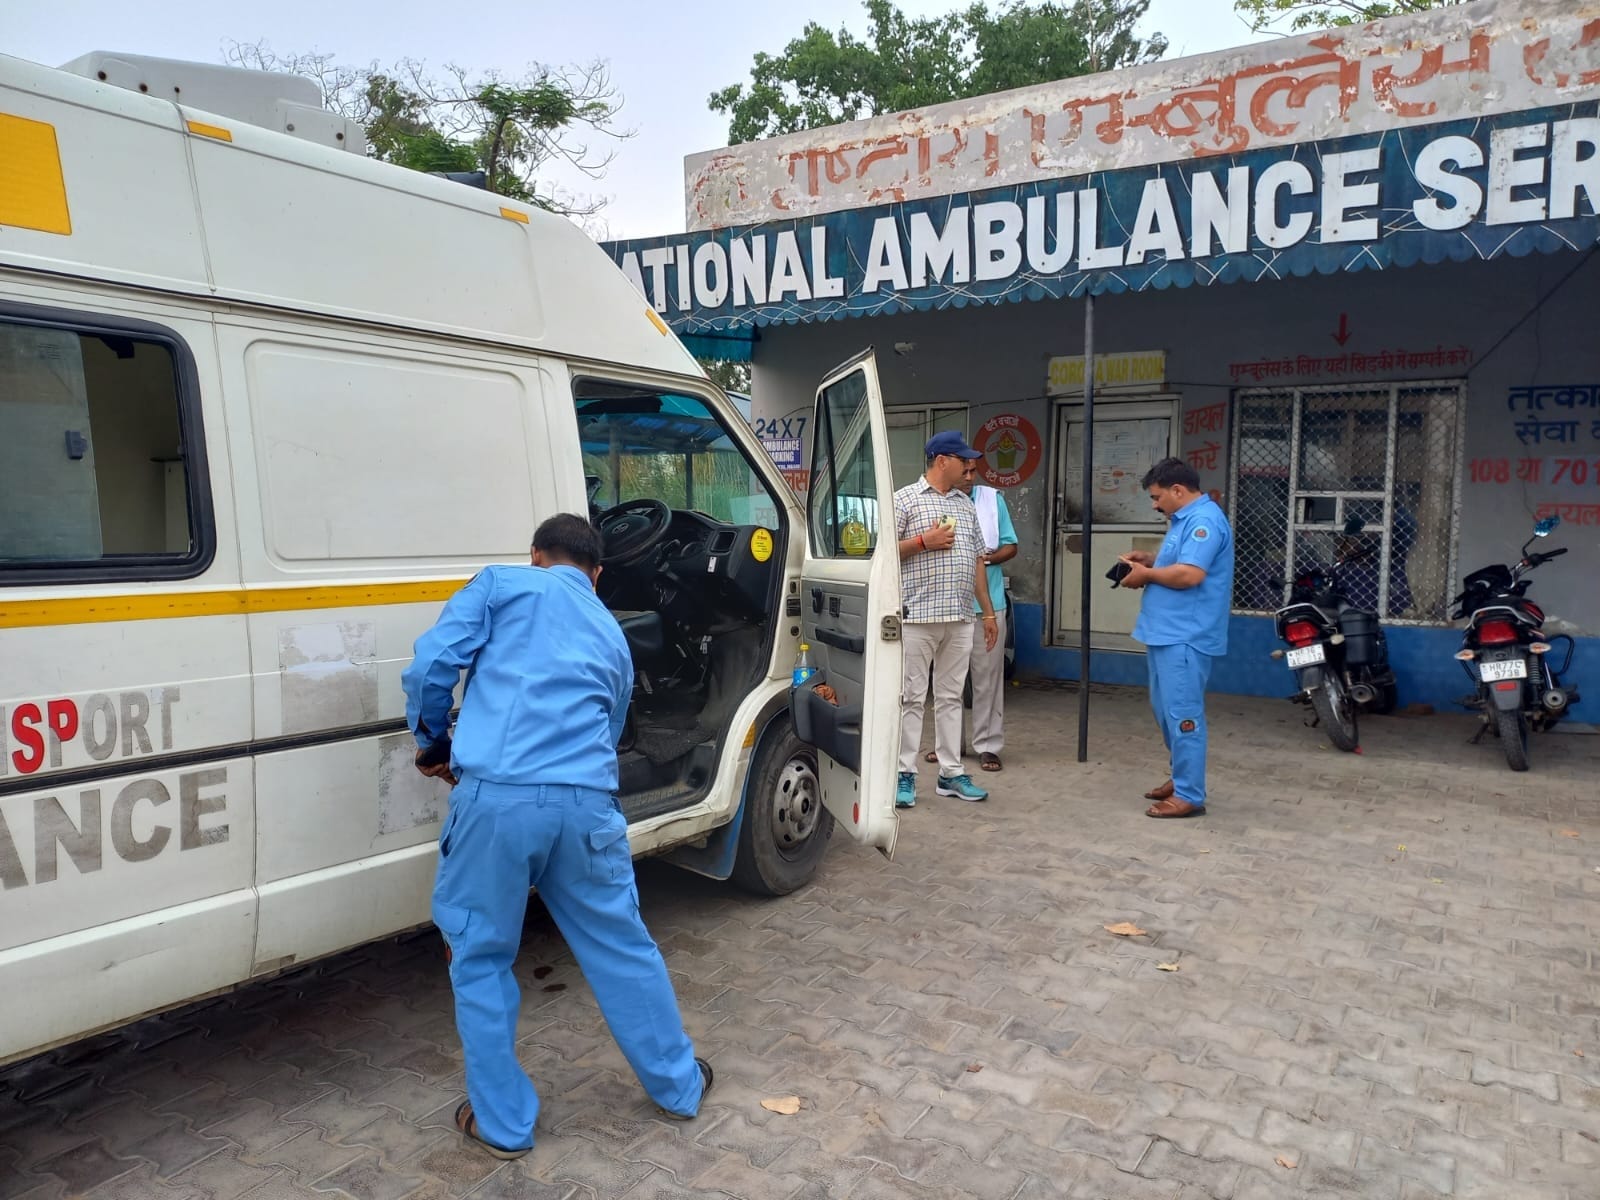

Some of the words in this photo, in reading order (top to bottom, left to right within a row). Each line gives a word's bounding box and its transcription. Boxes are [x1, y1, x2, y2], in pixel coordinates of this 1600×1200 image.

[862, 147, 1381, 293] AMBULANCE
[1412, 117, 1600, 232] SER
[1051, 359, 1104, 384] COROA
[1508, 384, 1600, 412] तत्का
[1514, 415, 1580, 446] सेवा
[1467, 457, 1511, 485] 108
[0, 686, 180, 776] SPORT
